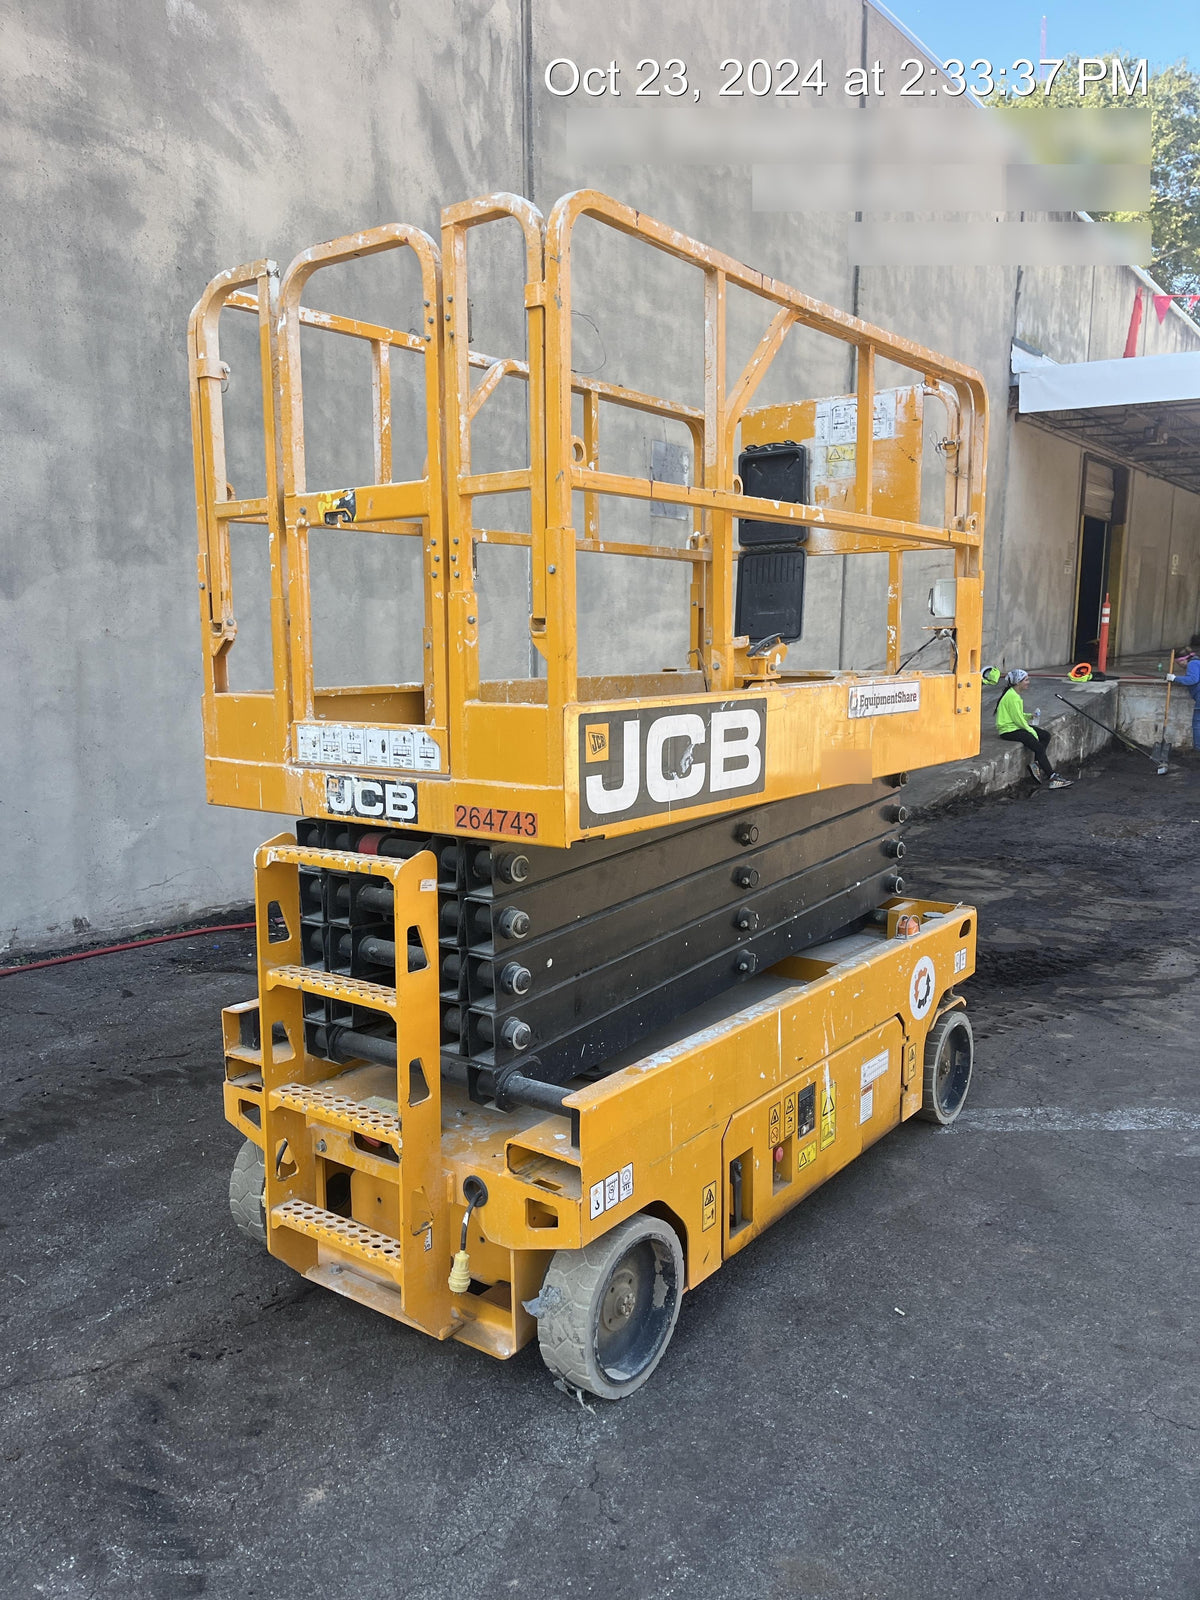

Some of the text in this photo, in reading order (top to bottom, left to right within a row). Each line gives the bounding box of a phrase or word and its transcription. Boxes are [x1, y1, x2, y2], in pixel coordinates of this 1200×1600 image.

[859, 690, 917, 710] EquipmentShare
[591, 734, 607, 752] JCB
[586, 709, 762, 815] JCB
[329, 779, 416, 820] JCB
[456, 804, 537, 837] 264743
